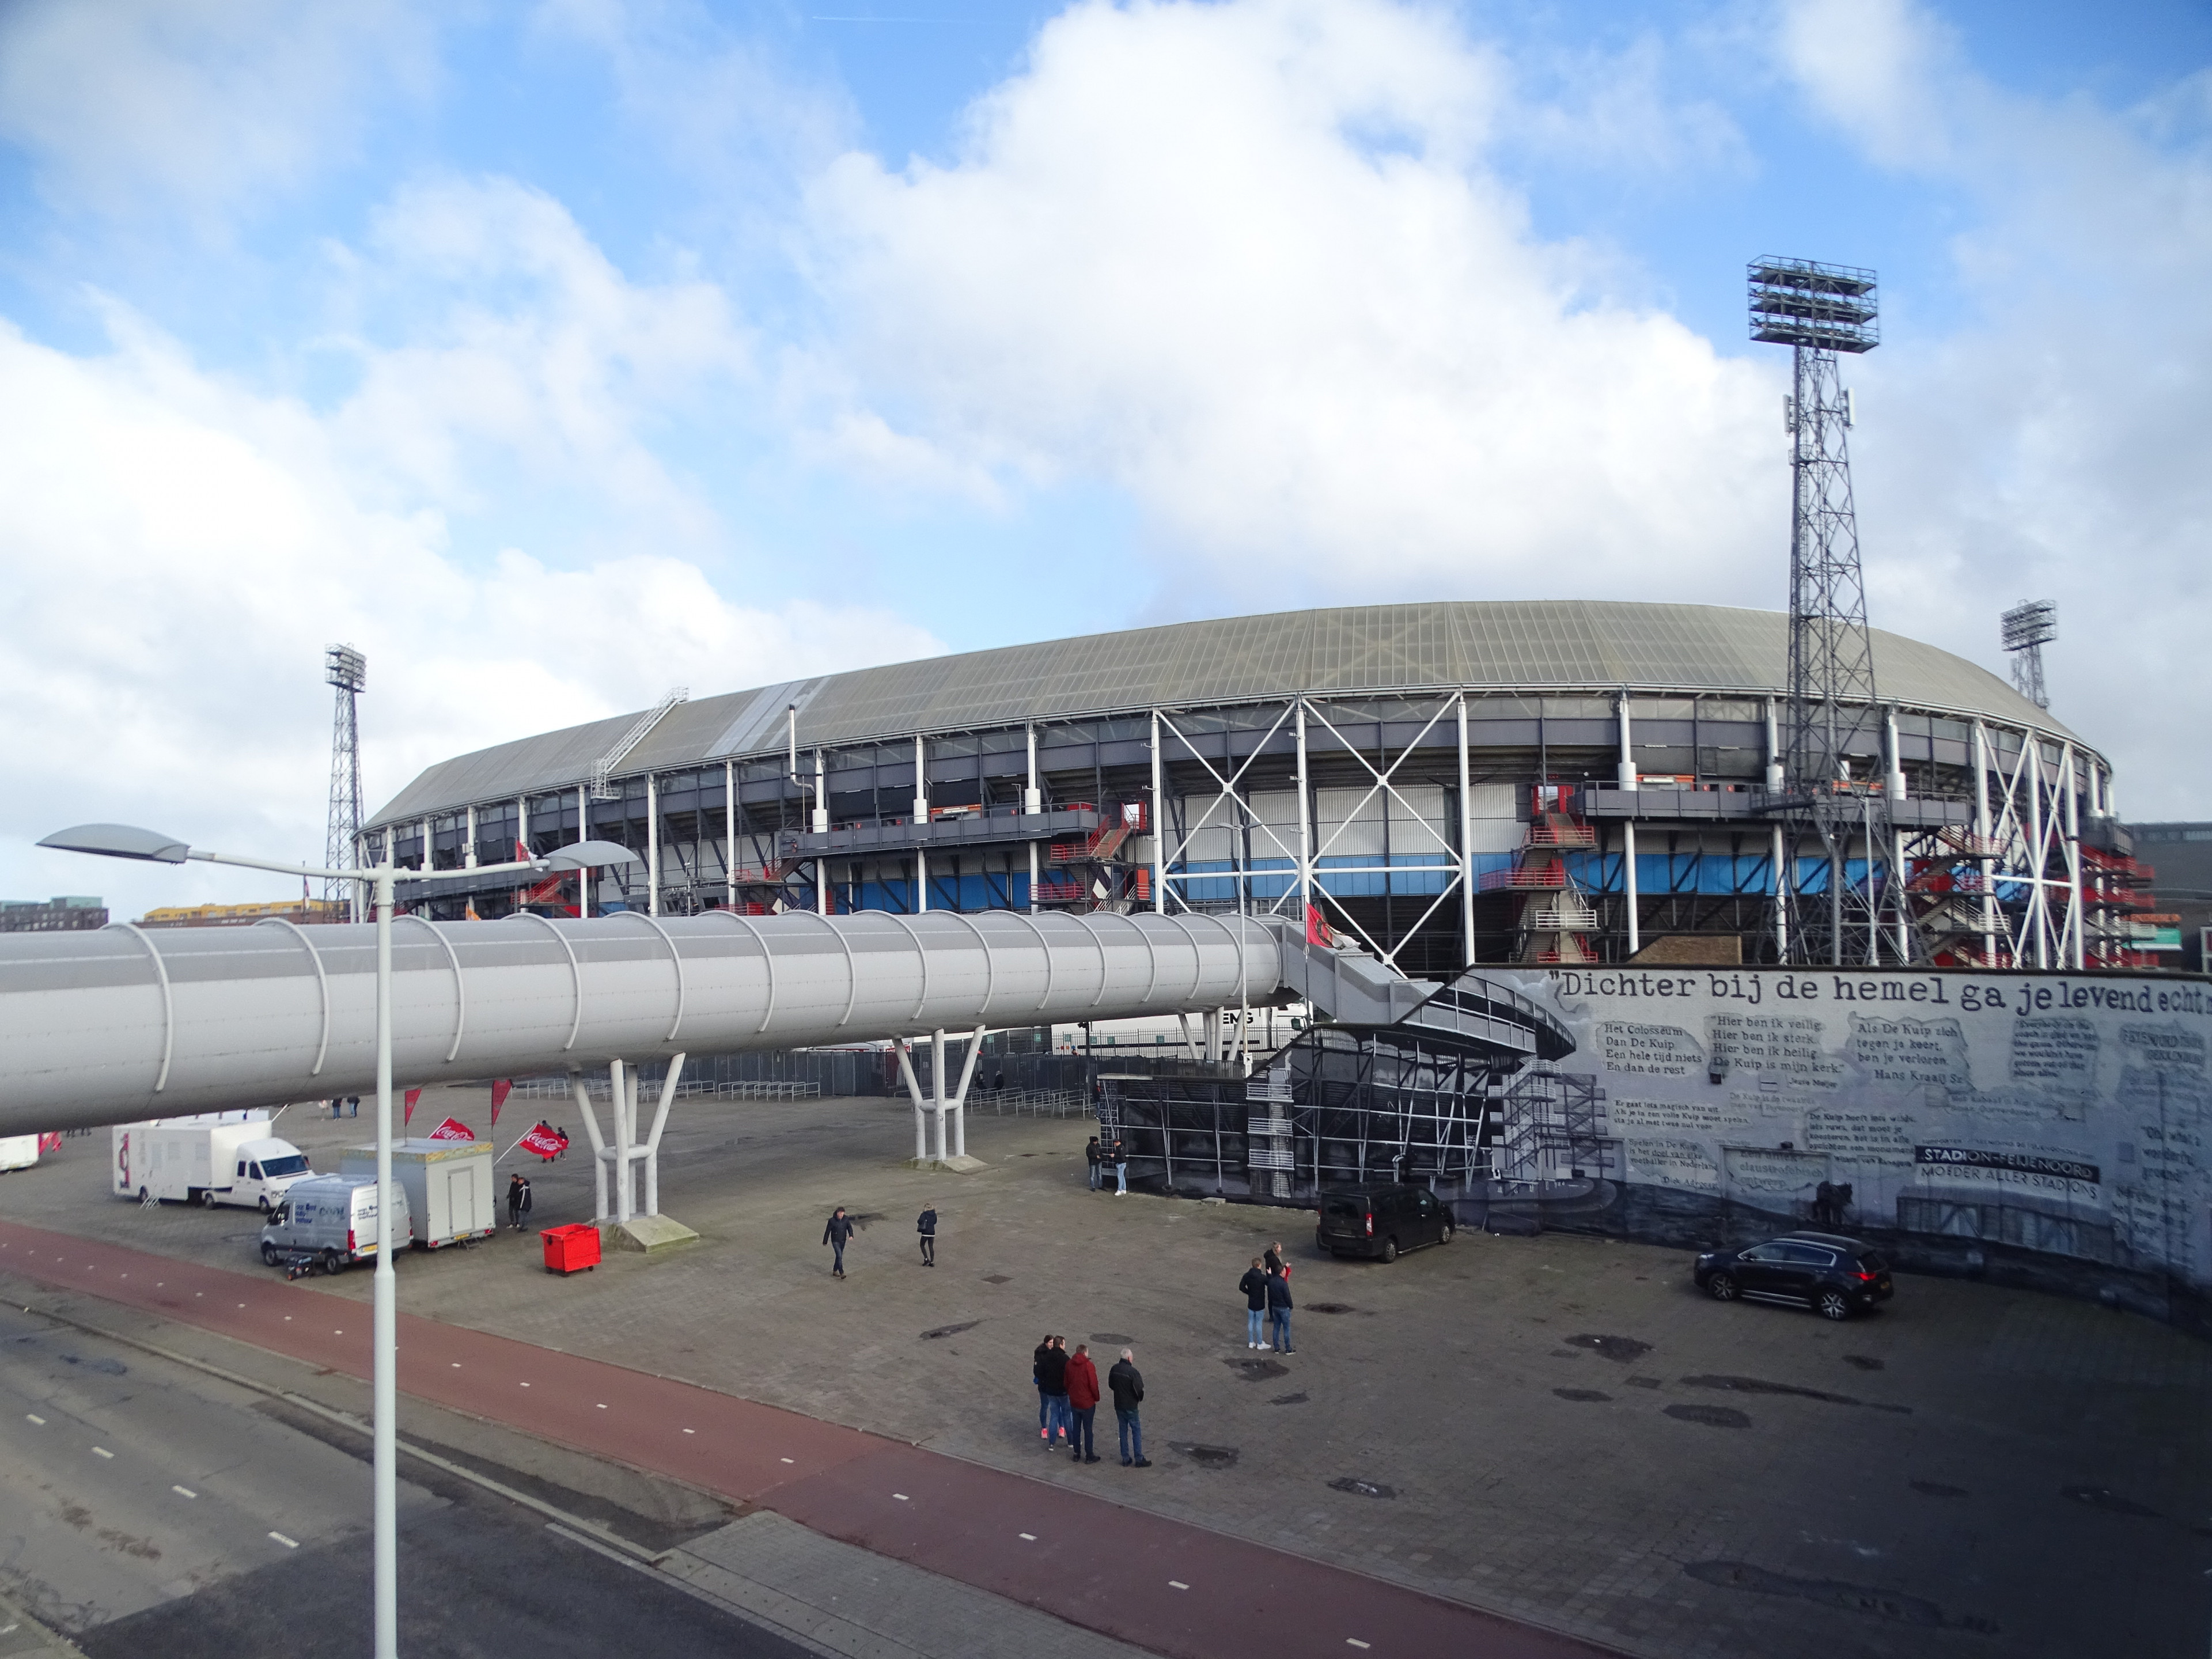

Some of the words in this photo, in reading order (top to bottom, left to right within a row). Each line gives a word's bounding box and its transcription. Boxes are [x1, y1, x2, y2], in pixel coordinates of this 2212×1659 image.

[1549, 970, 1695, 997] "Dichter
[1707, 974, 1762, 1005] bij
[1776, 975, 1819, 1000] de
[1832, 975, 1949, 1004] hemel
[1960, 984, 2007, 1012] ga
[2016, 982, 2052, 1016] je
[2056, 980, 2154, 1013] levend
[1223, 1012, 1253, 1024] EMG
[1747, 1017, 1767, 1028] ben
[1771, 1018, 1783, 1028] ik
[1604, 1024, 1623, 1033] Het
[1627, 1025, 1683, 1036] Colosseum
[1713, 1029, 1737, 1040] Hier
[1742, 1031, 1764, 1041] ben
[1767, 1032, 1779, 1042] ik
[1857, 1023, 1877, 1034] Als
[1881, 1024, 1899, 1034] De
[1902, 1024, 1931, 1038] Kuip
[1936, 1027, 1958, 1037] zich
[1606, 1036, 1626, 1046] Dan
[1630, 1037, 1645, 1047] De
[1649, 1039, 1675, 1050] Kuip
[1713, 1043, 1739, 1053] Hier
[1743, 1044, 1764, 1055] ben
[1767, 1046, 1779, 1056] ik
[1857, 1039, 1889, 1051] tegen
[1893, 1039, 1904, 1051] je
[1605, 1049, 1625, 1059] Een
[1630, 1050, 1650, 1060] hele
[1654, 1052, 1672, 1063] tijd
[1675, 1054, 1702, 1063] niets
[1857, 1052, 1879, 1063] ben
[1883, 1052, 1895, 1065] je
[1606, 1062, 1620, 1071] En
[1624, 1063, 1645, 1072] dan
[1647, 1064, 1660, 1073] de
[1664, 1066, 1685, 1075] rest
[1713, 1056, 1730, 1066] De
[1734, 1058, 1762, 1070] Kuip
[1766, 1059, 1776, 1069] is
[1781, 1061, 1808, 1073] mijn
[1874, 1069, 1905, 1081] Hans
[1660, 1103, 1690, 1112] magisch
[1681, 1112, 1700, 1122] Kuip
[1921, 1165, 1980, 1180] MOEDER
[1985, 1169, 2027, 1185] ALLER
